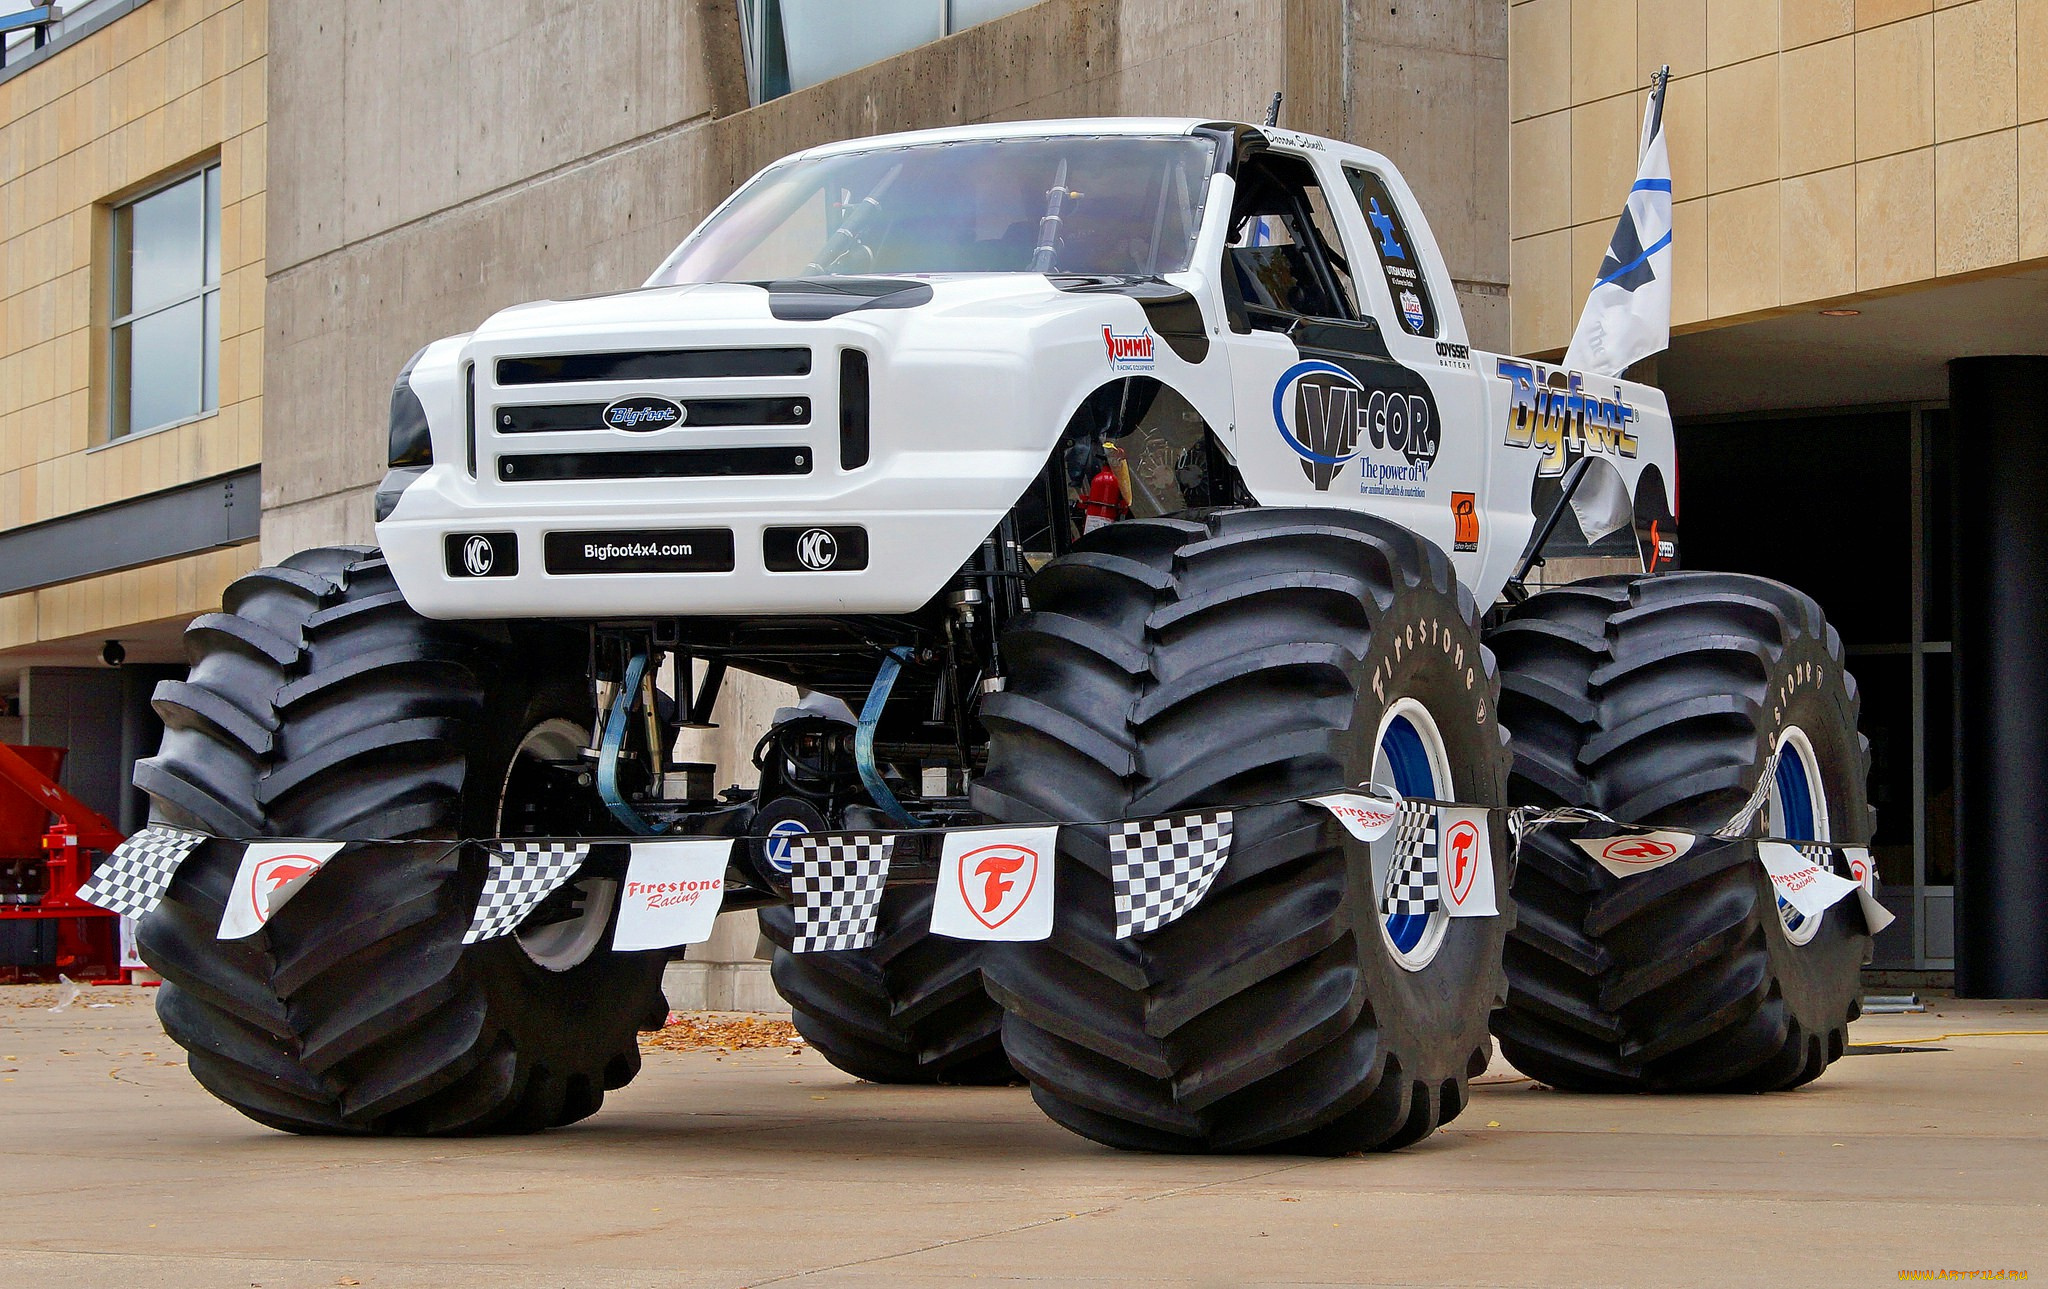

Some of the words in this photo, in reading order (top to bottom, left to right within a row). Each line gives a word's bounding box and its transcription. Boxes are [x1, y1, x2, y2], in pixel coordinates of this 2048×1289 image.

[1405, 302, 1420, 313] LUCAS
[1104, 328, 1152, 363] SUMMIT
[1435, 341, 1470, 360] ODYSSEY
[1439, 359, 1471, 370] BATTERY
[610, 406, 677, 427] Bigfoot
[1496, 357, 1639, 478] Bigfoot
[1360, 456, 1378, 479] The
[1379, 464, 1408, 485] power
[1408, 460, 1420, 482] of
[1360, 482, 1369, 494] for
[467, 538, 490, 573] KC
[584, 542, 692, 561] Bigfoot4x4.com
[802, 532, 832, 568] KC
[1372, 618, 1475, 705] Firestone
[1770, 866, 1820, 887] Firestone
[627, 879, 721, 898] Firestone
[645, 890, 700, 911] Racing
